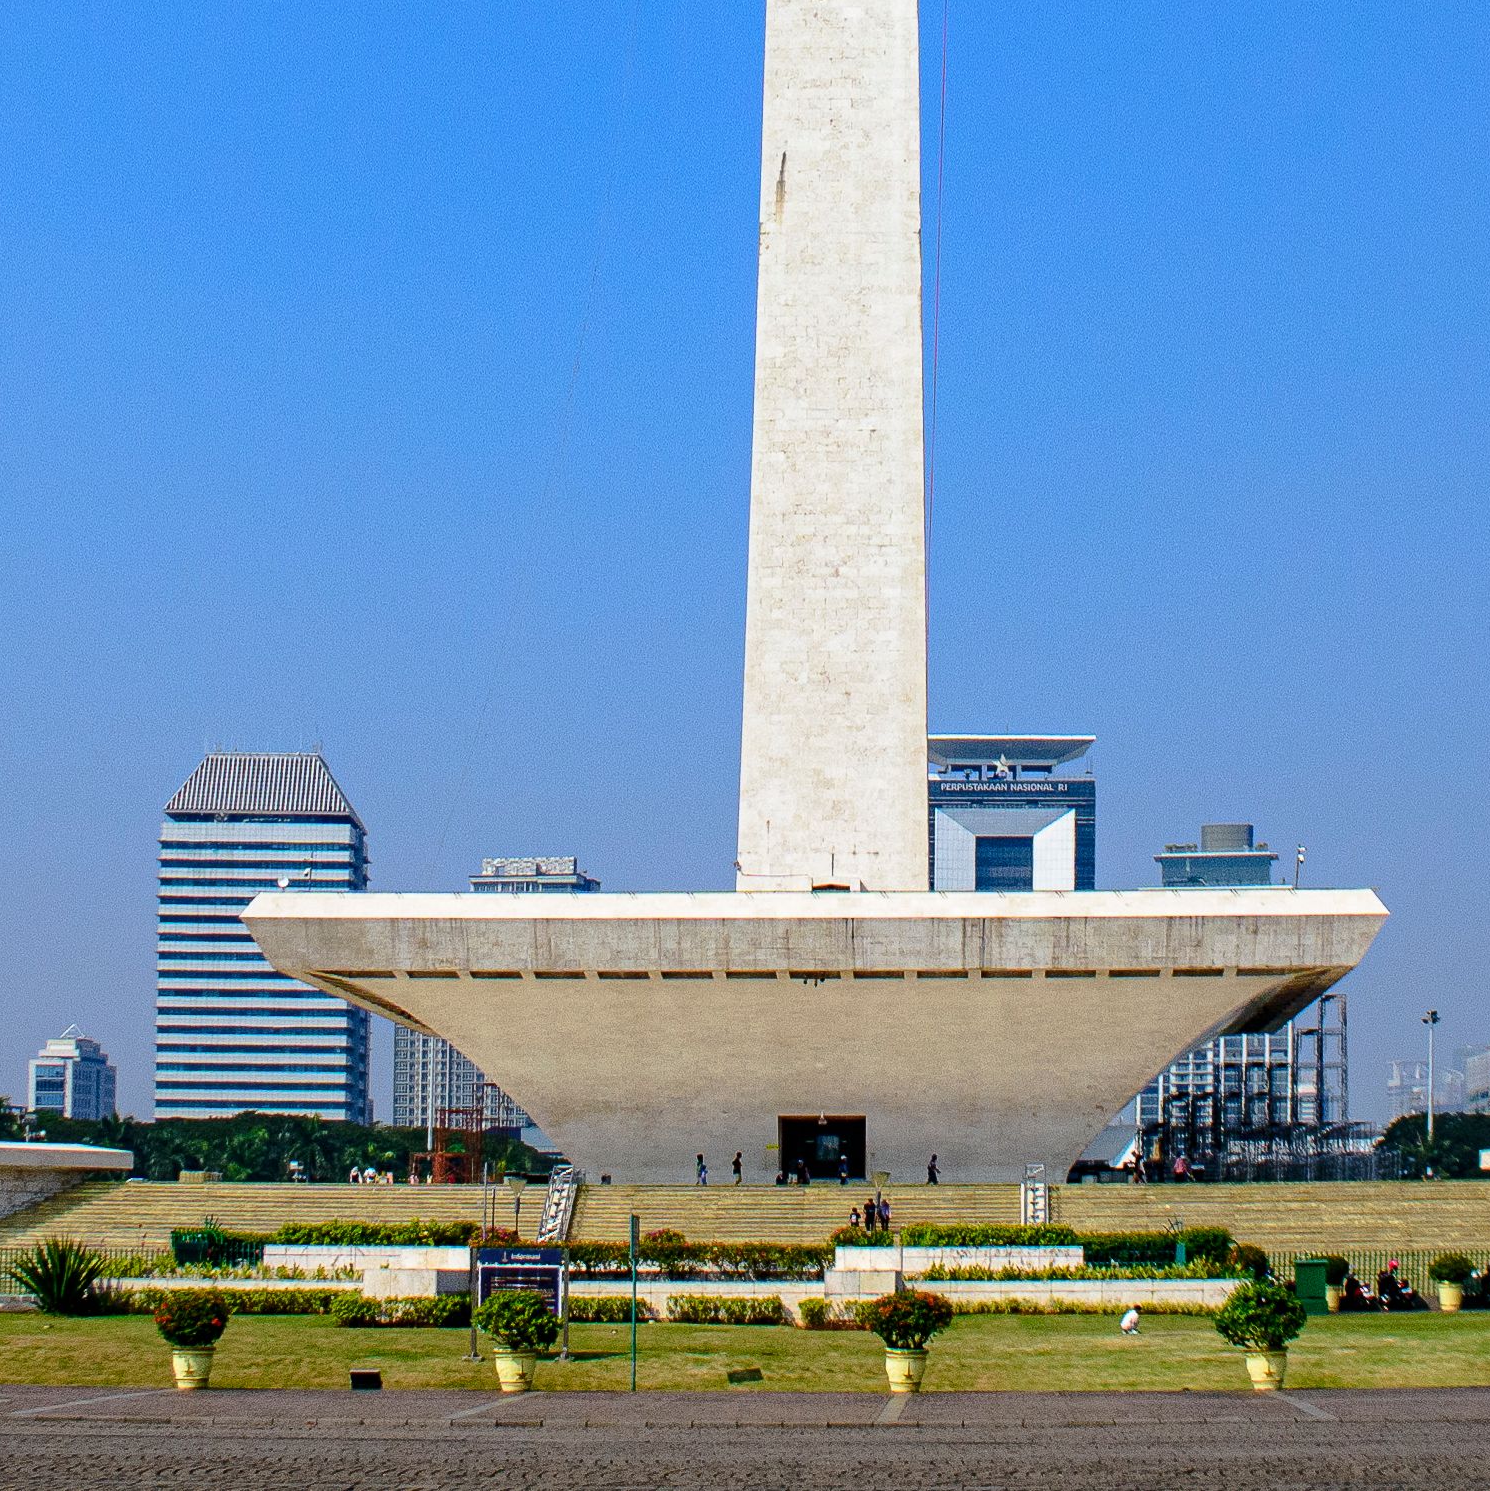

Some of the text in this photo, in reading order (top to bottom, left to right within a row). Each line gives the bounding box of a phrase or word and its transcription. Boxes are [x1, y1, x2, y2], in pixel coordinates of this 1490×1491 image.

[941, 782, 1068, 791] PERPUSTAKAAN NASIONAL RI
